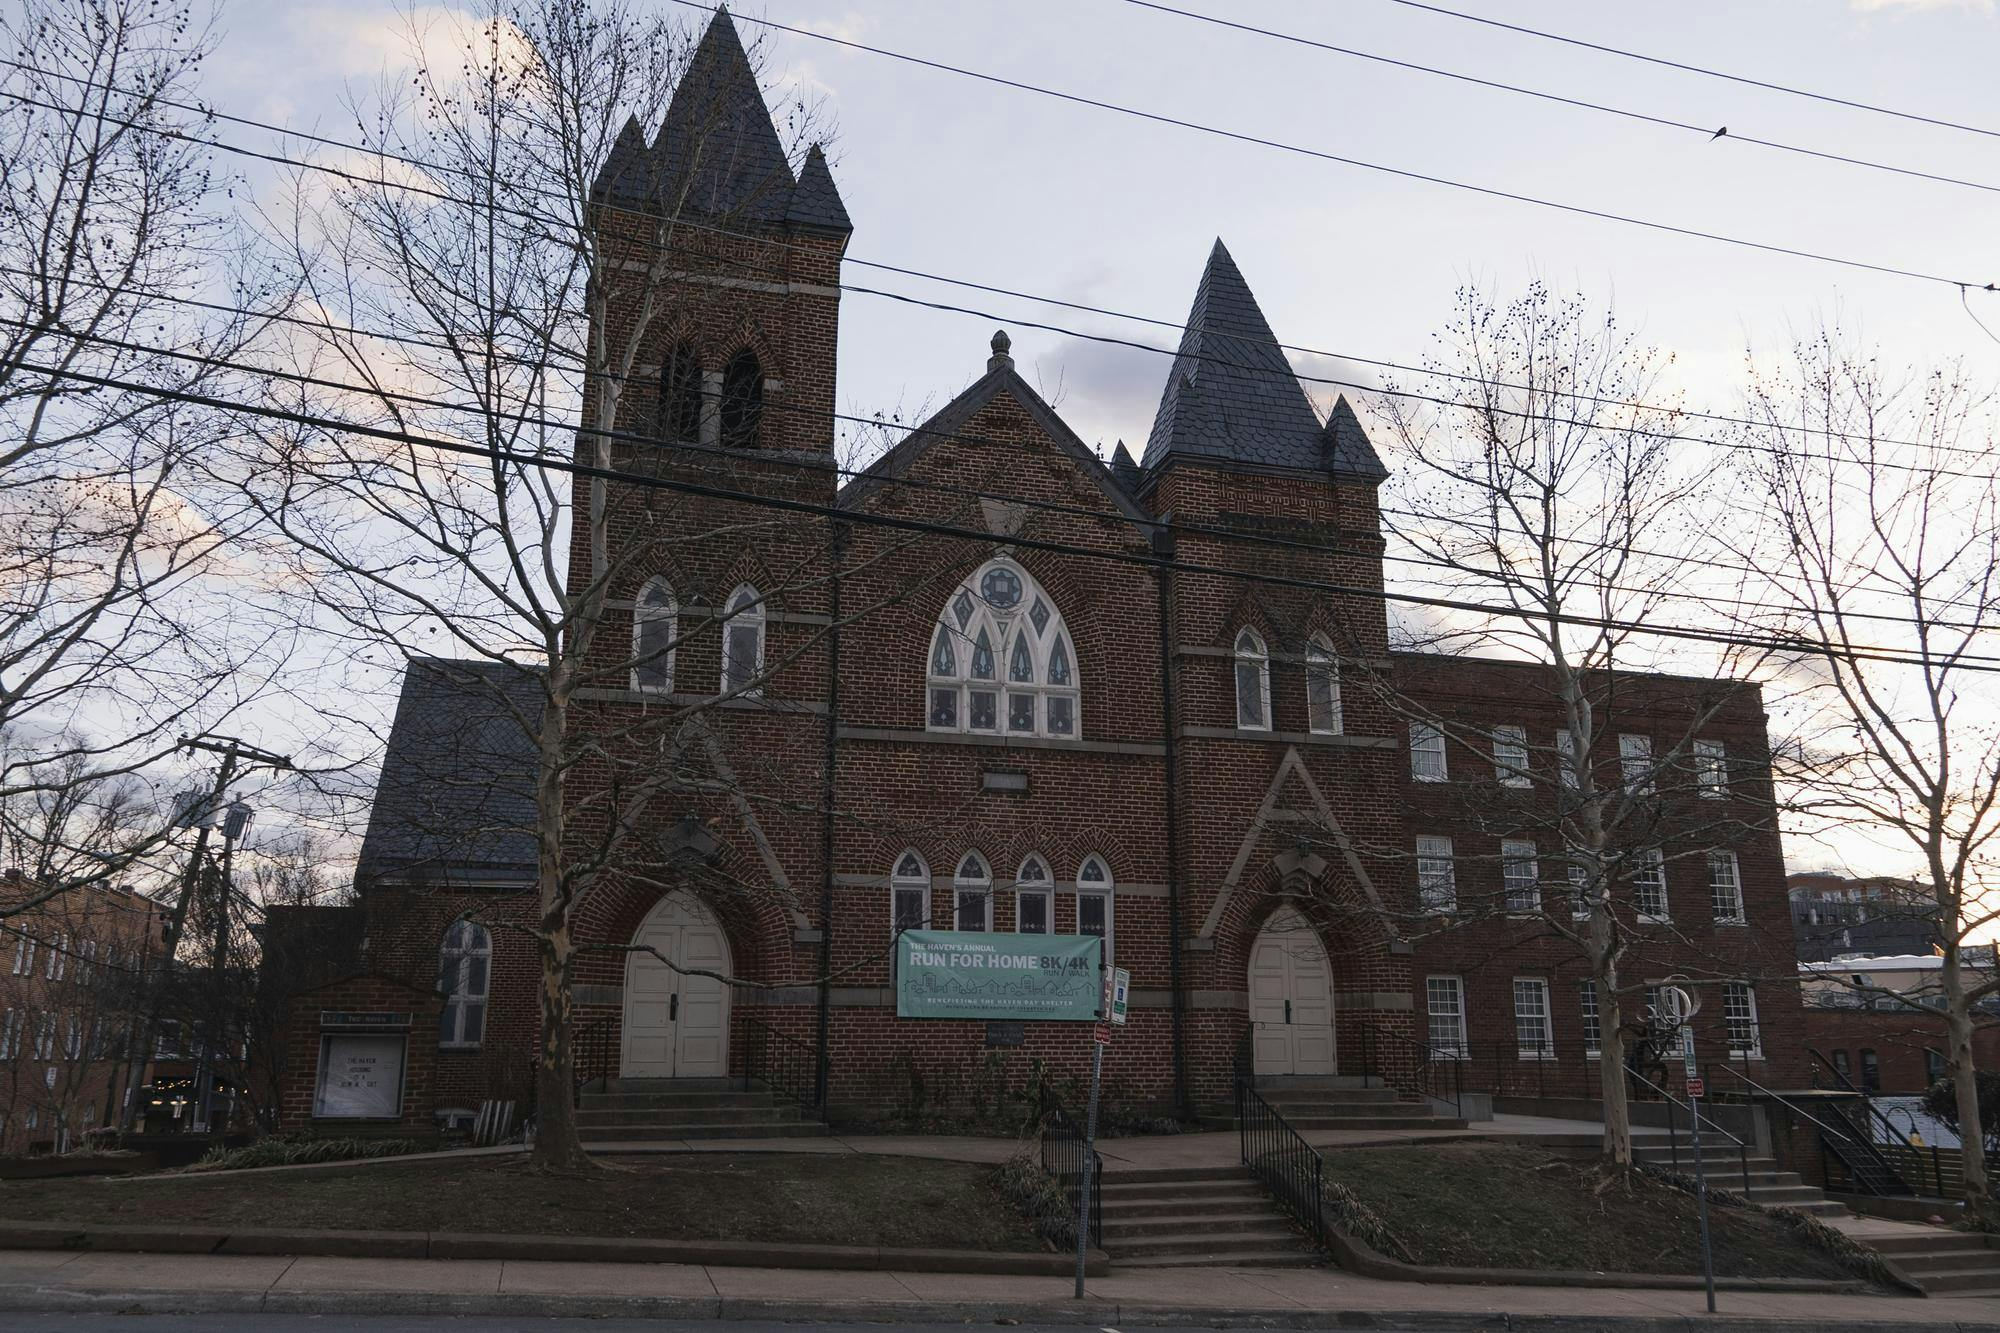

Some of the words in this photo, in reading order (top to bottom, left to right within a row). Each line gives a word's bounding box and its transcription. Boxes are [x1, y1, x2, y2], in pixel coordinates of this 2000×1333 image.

[911, 942, 926, 950] THE
[927, 943, 962, 951] HAVEN'S
[963, 944, 997, 952] ANNUAL
[910, 952, 946, 967] RUN
[950, 953, 984, 968] FOR
[988, 954, 1038, 969] HOME
[1068, 970, 1090, 978] WALK
[980, 998, 995, 1006] THE
